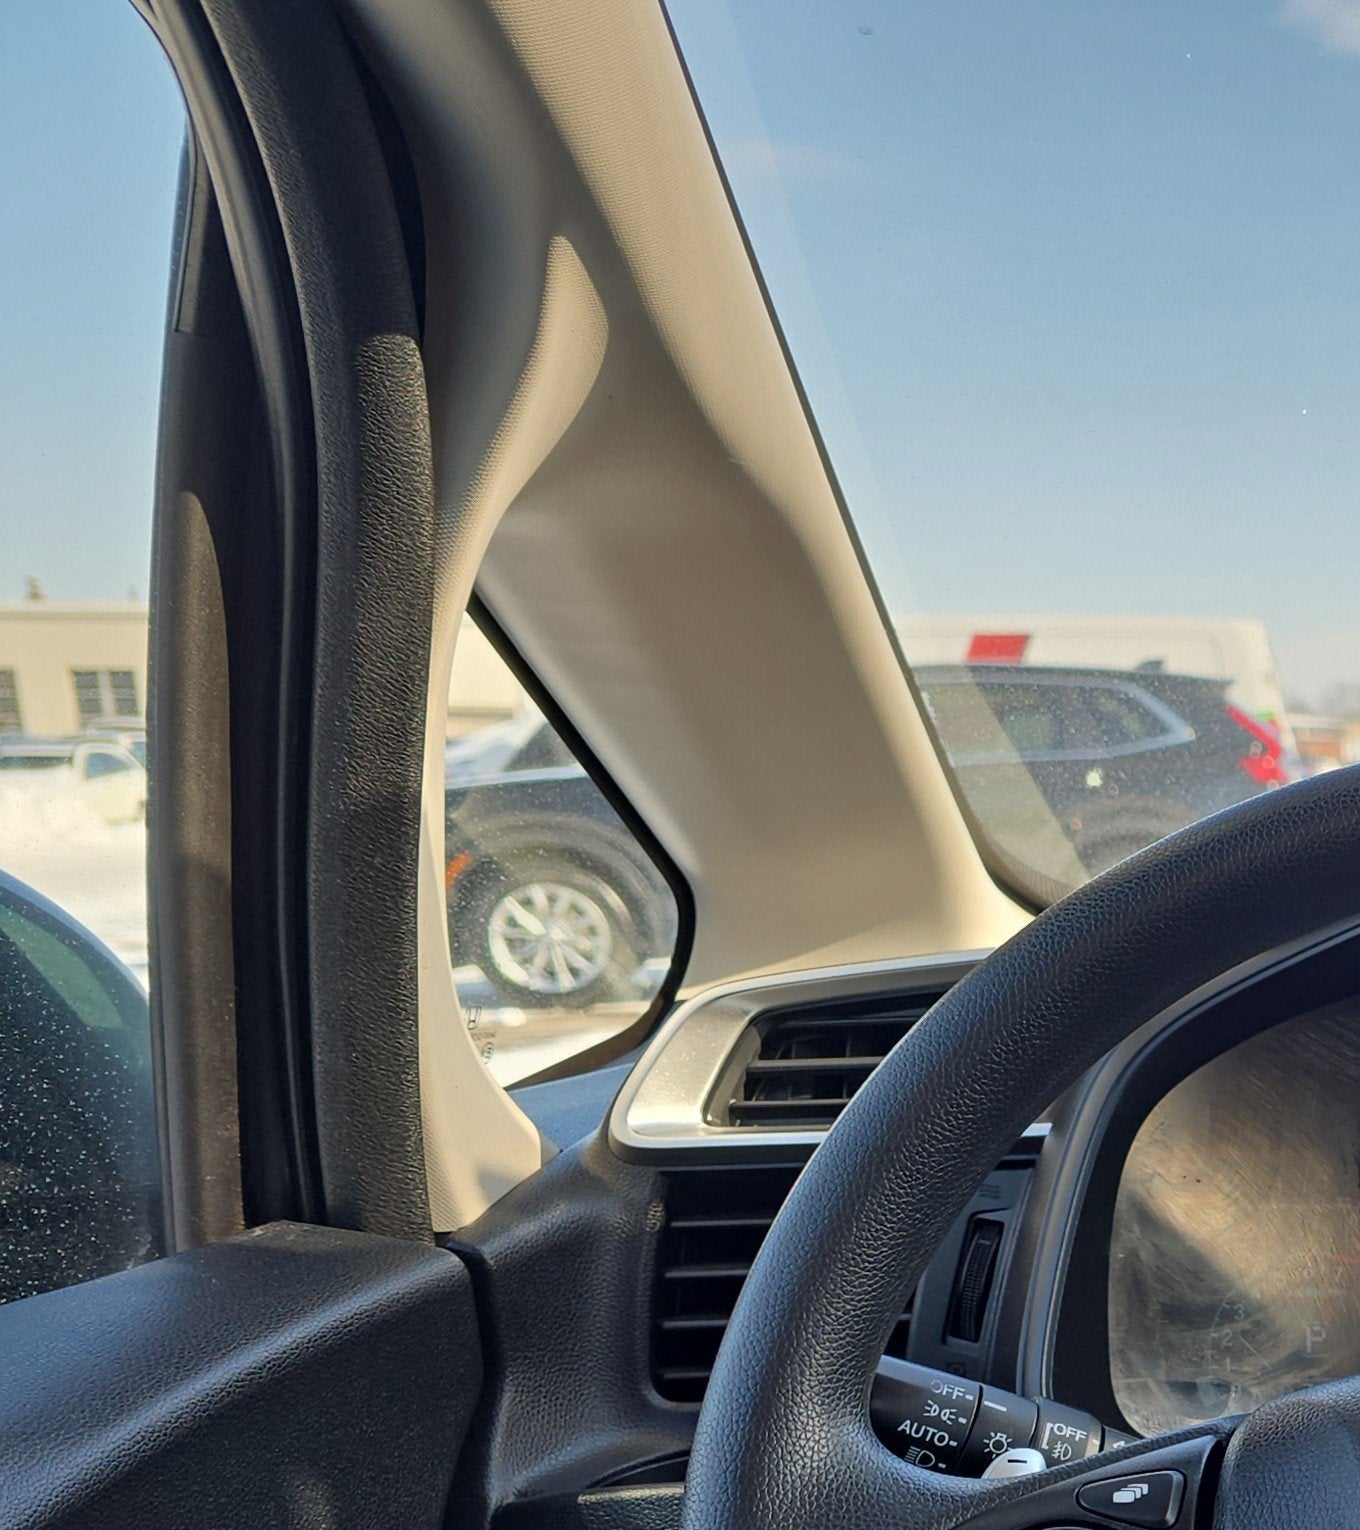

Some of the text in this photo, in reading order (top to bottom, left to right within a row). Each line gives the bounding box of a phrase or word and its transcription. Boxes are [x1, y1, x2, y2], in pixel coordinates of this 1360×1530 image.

[1222, 1329, 1233, 1347] 2
[1306, 1325, 1327, 1353] P
[930, 1379, 965, 1400] OFF
[897, 1419, 949, 1446] AUTO
[1053, 1422, 1087, 1441] OFF
